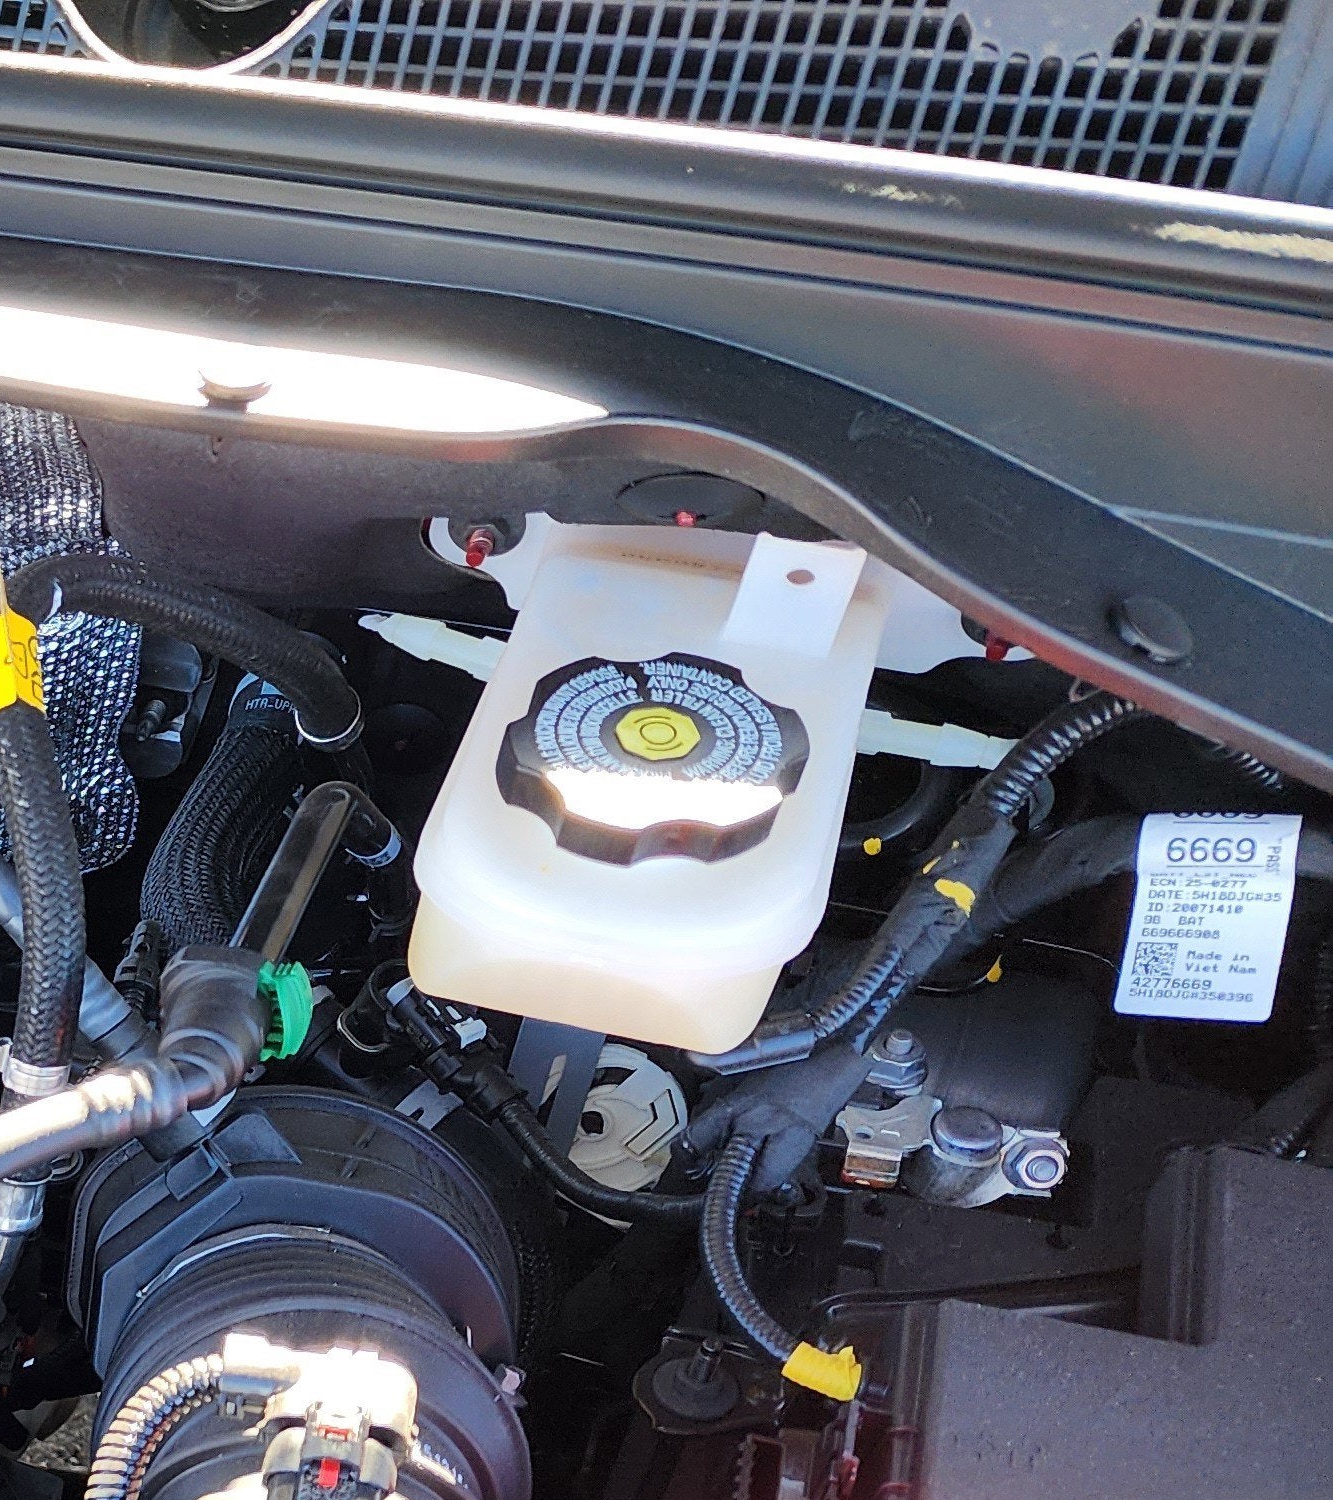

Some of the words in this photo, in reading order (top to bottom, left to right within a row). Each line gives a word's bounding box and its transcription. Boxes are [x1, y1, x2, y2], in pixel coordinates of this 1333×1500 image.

[647, 675, 689, 690] ONLY
[651, 688, 705, 711] FILLER
[1167, 837, 1256, 863] 6669
[1186, 951, 1222, 961] Made
[1233, 953, 1249, 961] in
[1185, 962, 1218, 973] Viet
[1228, 963, 1256, 974] Nam
[1132, 977, 1211, 989] 42776669
